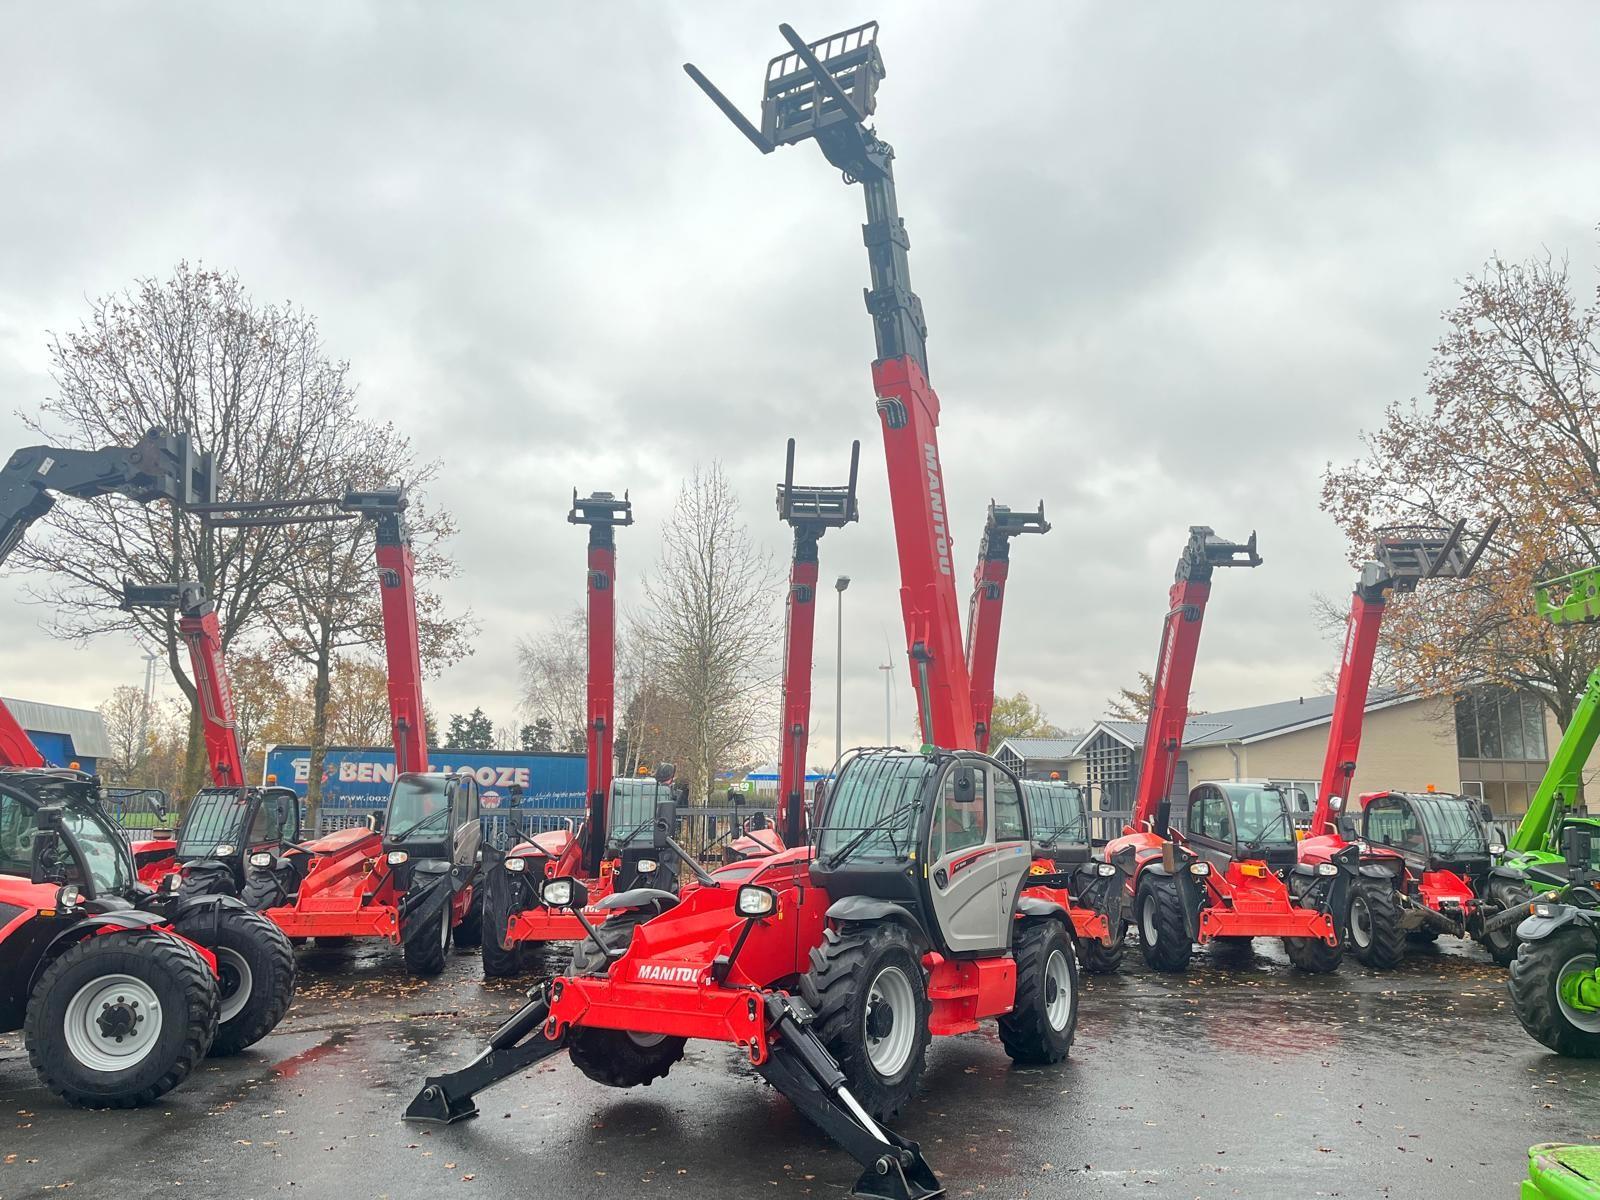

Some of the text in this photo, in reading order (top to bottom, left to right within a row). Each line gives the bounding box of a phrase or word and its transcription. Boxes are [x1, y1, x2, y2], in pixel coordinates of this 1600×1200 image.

[925, 443, 950, 575] MANITOU
[213, 650, 233, 721] MANITOU
[339, 792, 392, 803] www.looz
[638, 965, 701, 982] MANITOU
